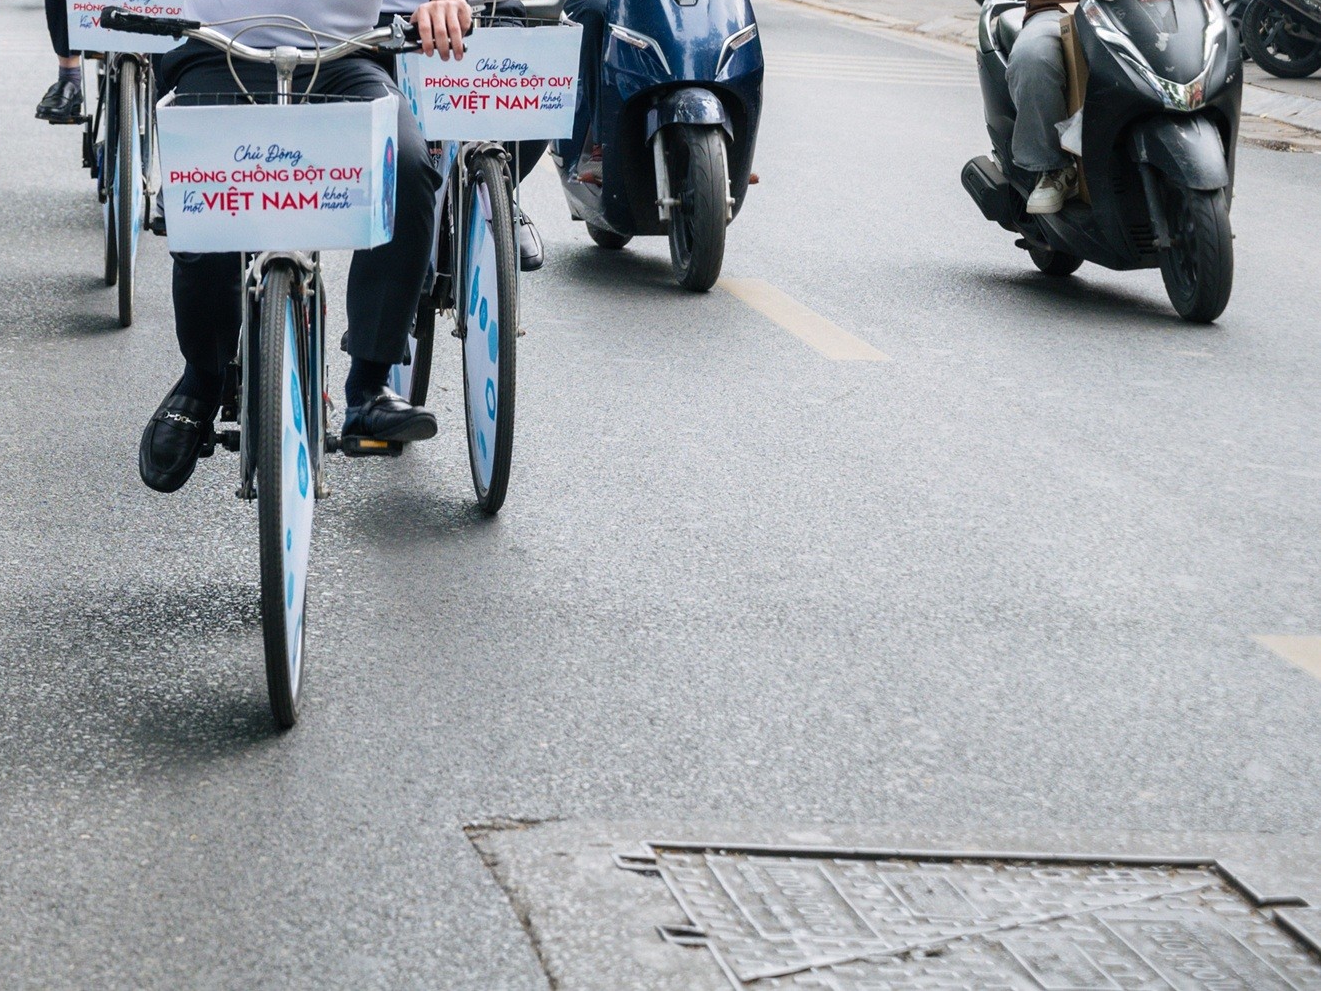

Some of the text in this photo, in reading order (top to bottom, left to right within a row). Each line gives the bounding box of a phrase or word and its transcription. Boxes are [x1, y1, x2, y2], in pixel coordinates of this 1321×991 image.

[145, 5, 163, 16] ĐỘT
[475, 58, 529, 76] Chủ Động
[425, 73, 573, 90] PHÒNG CHỐNG ĐỘT QUỴ
[434, 93, 445, 104] Vì
[449, 91, 539, 114] VIỆT NAM
[540, 102, 564, 110] mạnh
[234, 144, 303, 167] Chủ Động
[170, 164, 363, 185] PHÒNG CHỐNG ĐỘT QUỴ
[183, 191, 196, 204] Vì
[202, 187, 319, 216] VIỆT NAM
[320, 199, 352, 211] mạnh
